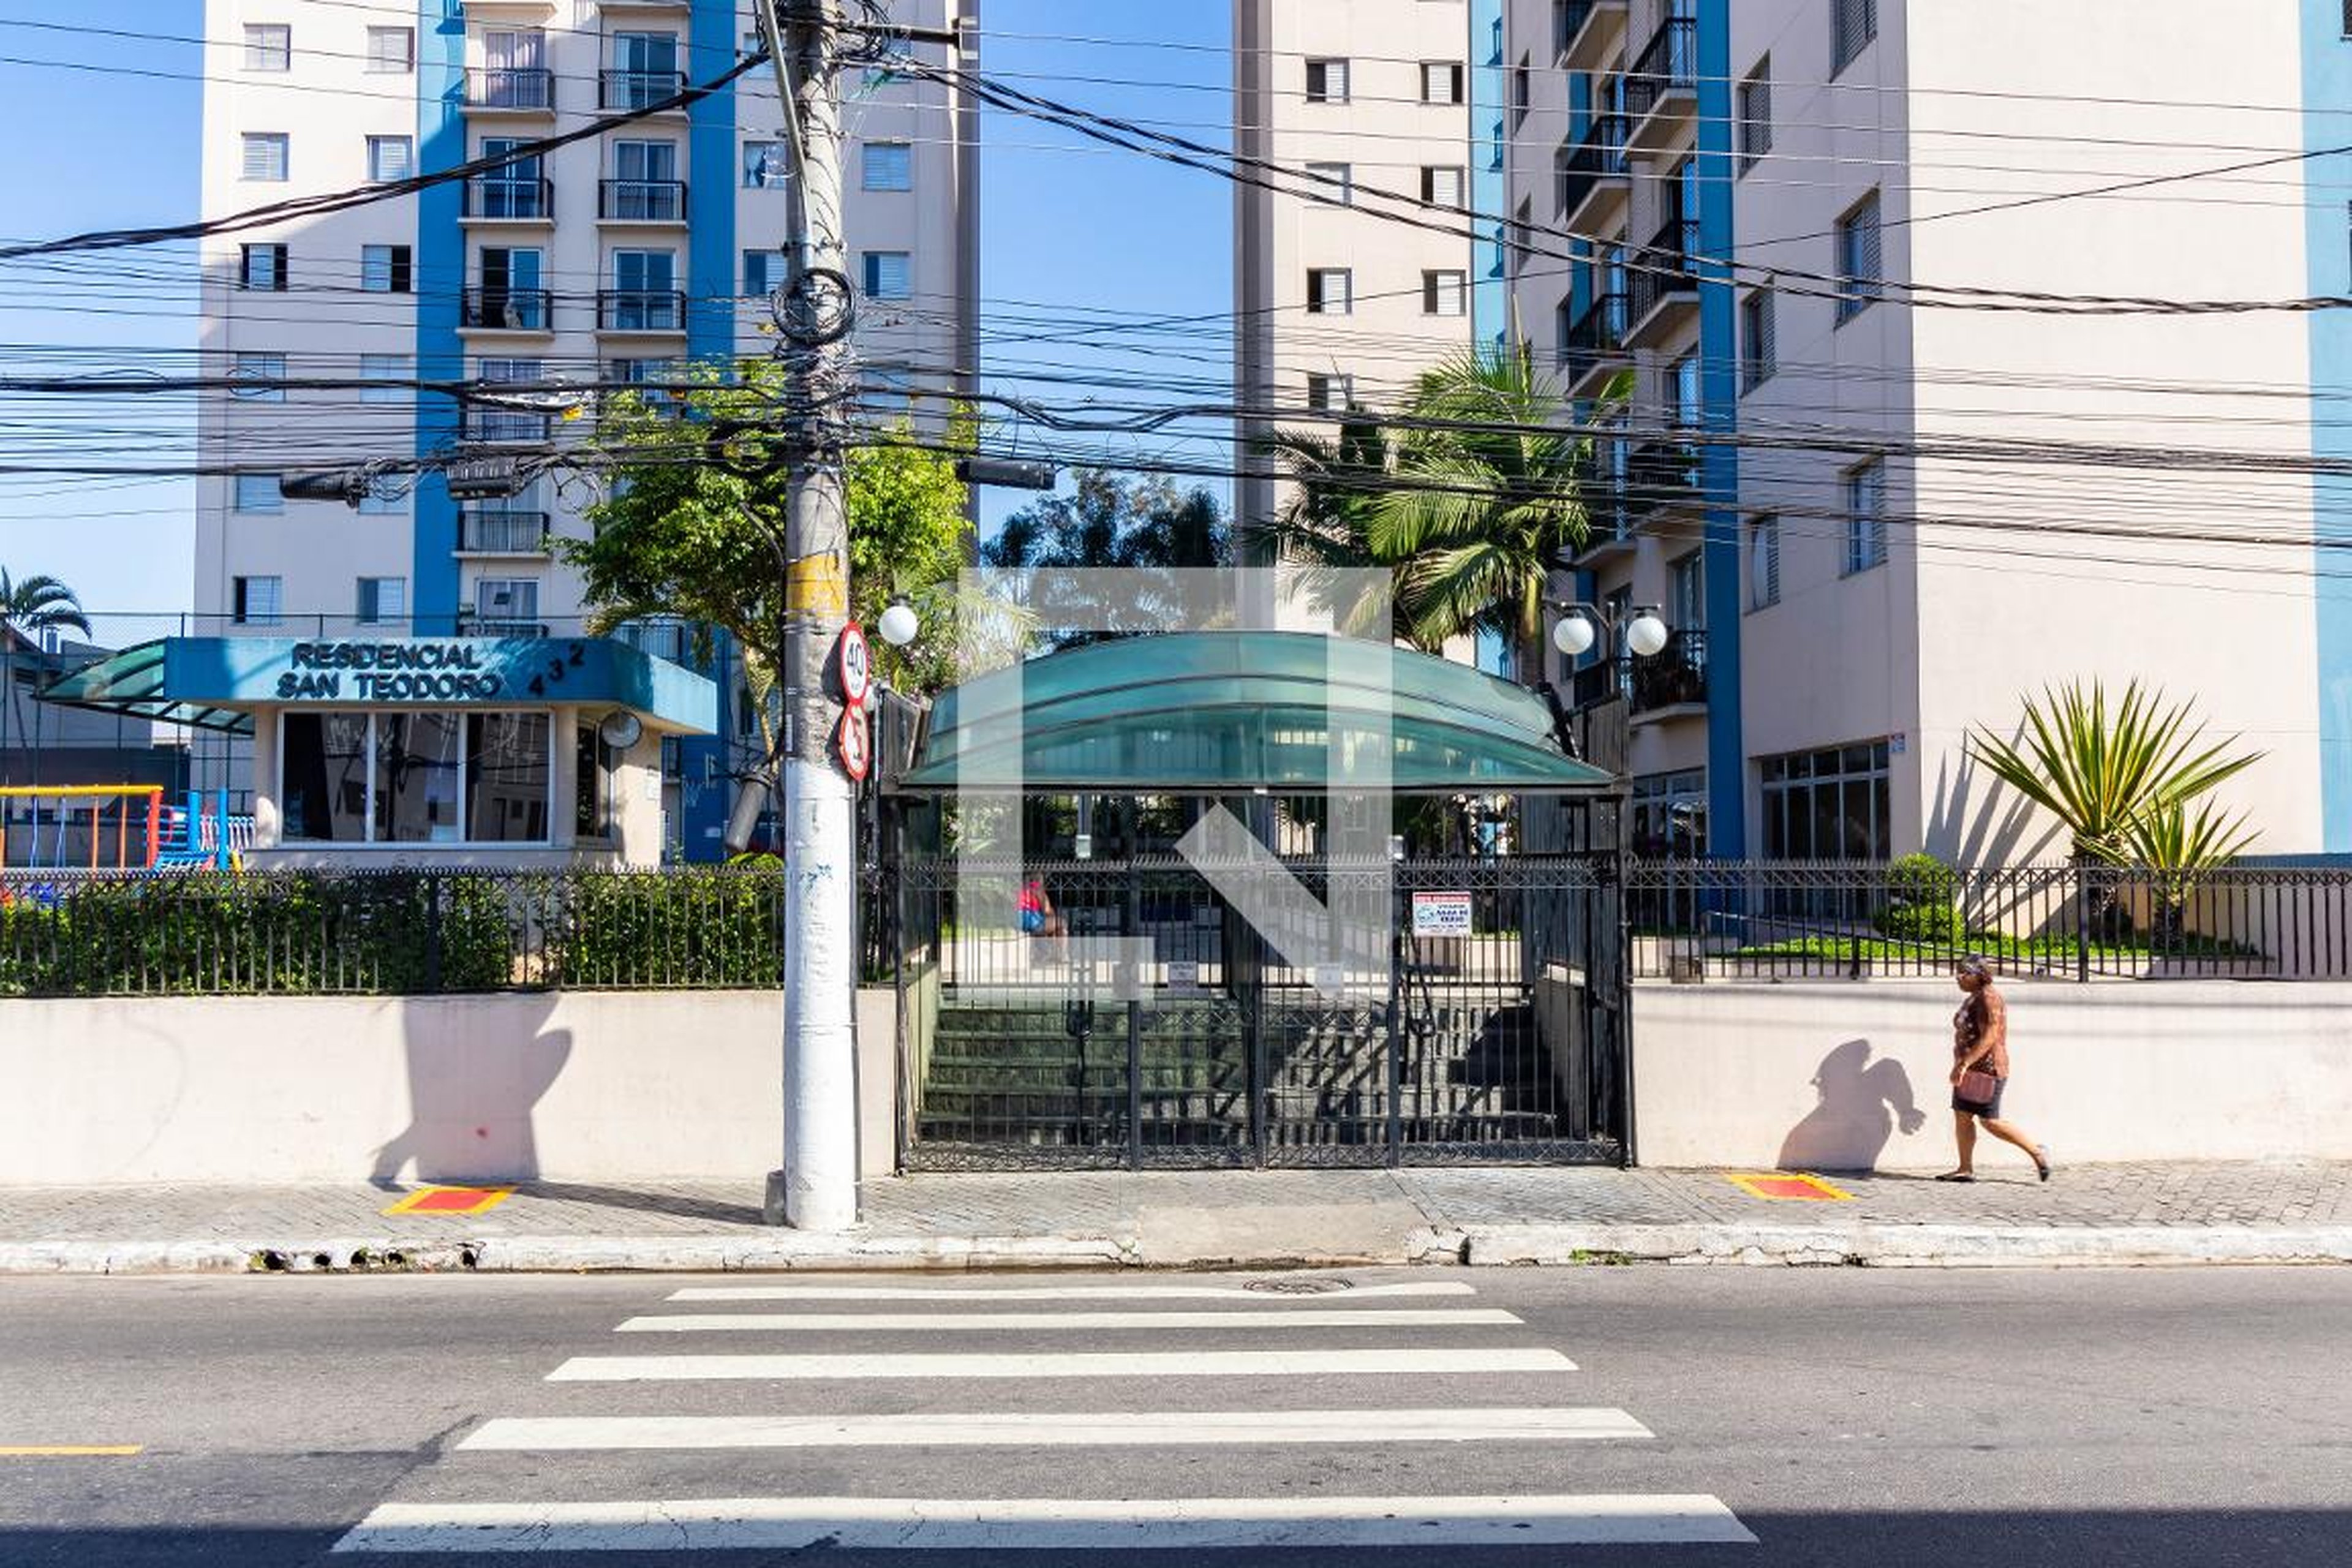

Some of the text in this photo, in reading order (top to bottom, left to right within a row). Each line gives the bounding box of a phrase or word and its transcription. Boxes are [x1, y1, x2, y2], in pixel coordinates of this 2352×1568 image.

[846, 643, 864, 677] 40
[277, 673, 501, 699] SAN TEODORO
